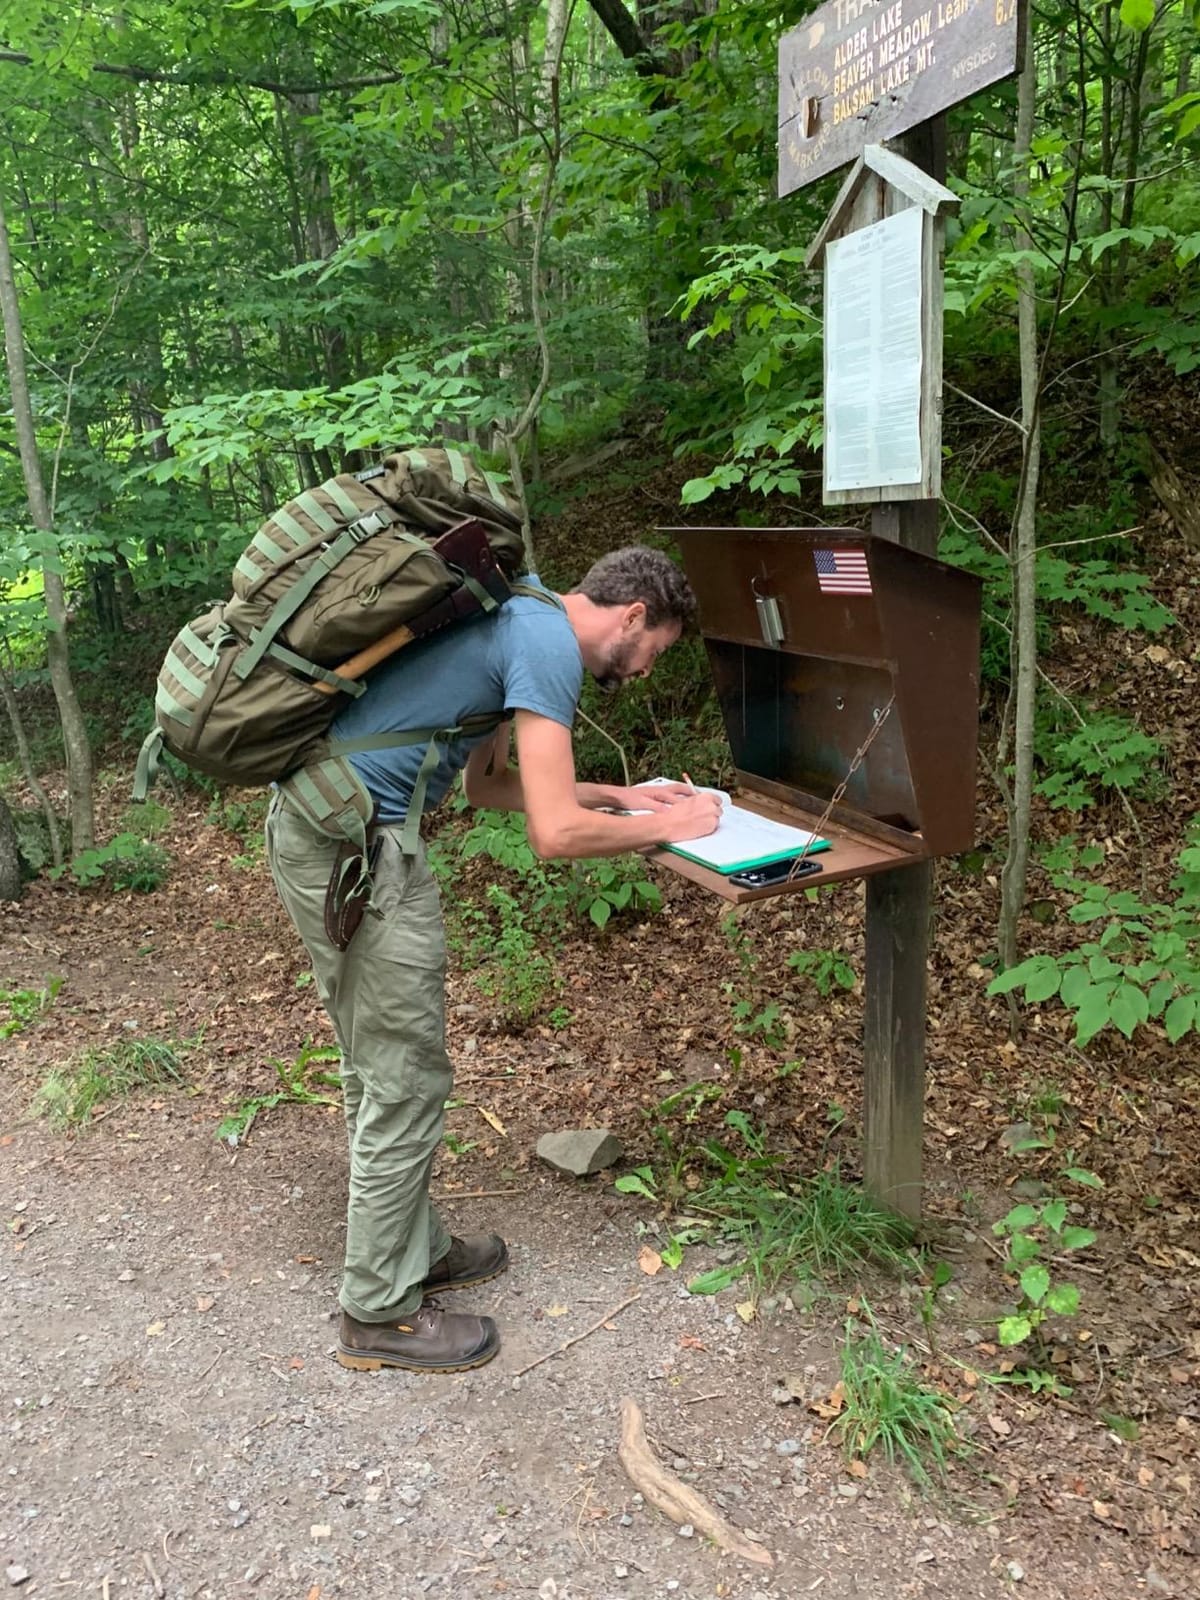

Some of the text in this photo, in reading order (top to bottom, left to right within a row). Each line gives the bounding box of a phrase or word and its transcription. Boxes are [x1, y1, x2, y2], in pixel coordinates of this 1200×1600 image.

[833, 1, 903, 71] ALDER LAKE
[833, 51, 874, 98] BEAVER
[879, 10, 932, 68] MEADOW
[952, 41, 997, 80] NYSDEC
[832, 39, 936, 126] BALSAM LAKE MT.
